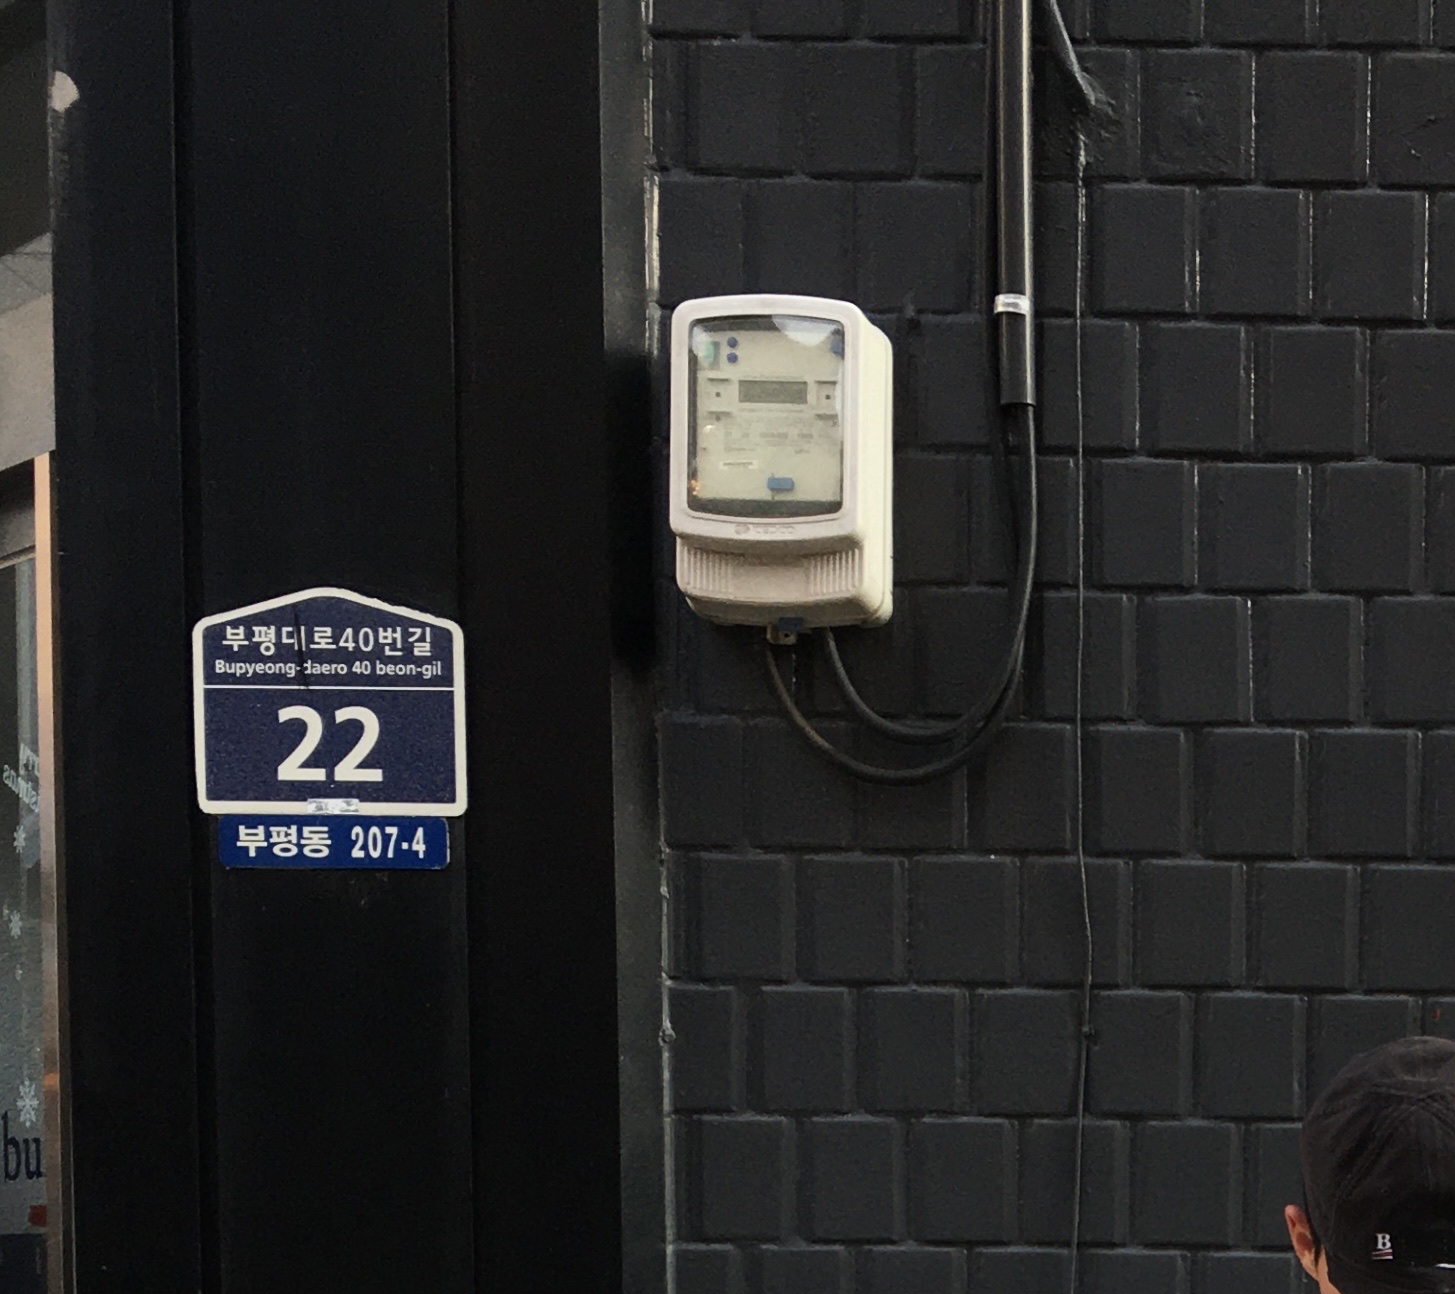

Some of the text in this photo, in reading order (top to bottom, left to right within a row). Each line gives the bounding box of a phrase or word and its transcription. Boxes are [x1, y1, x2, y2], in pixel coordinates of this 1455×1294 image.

[222, 625, 432, 656] 부평대로40번길
[215, 659, 442, 679] Bupyeong-daero 40 beon-gil
[277, 705, 383, 782] 22
[236, 824, 426, 859] 부평동 207-4
